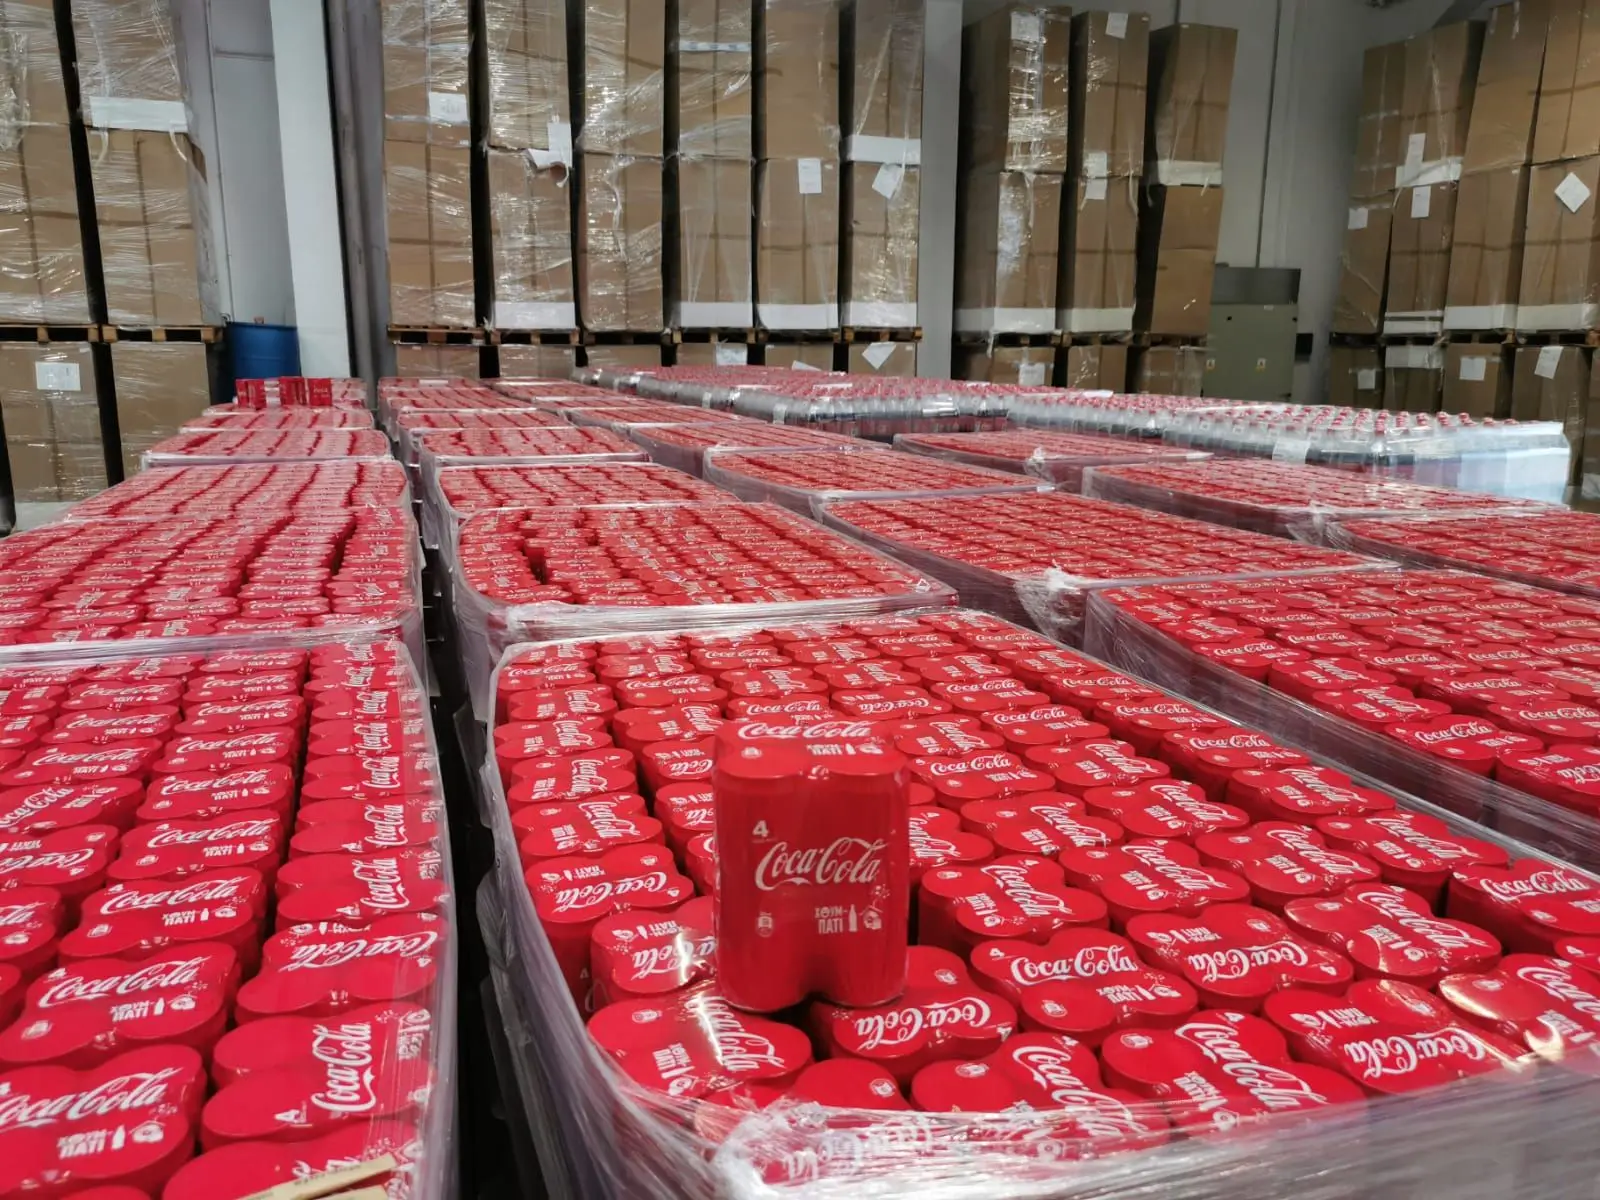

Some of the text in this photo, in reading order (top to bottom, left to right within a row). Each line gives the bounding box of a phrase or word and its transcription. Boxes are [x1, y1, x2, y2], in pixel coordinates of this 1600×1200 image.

[1214, 641, 1276, 656] Coca-Cola
[1288, 632, 1347, 644] Coca-Cola
[705, 649, 770, 658] Coca-Cola
[1374, 654, 1440, 665] Coca-Cola
[203, 674, 291, 688] Coca-Cola
[508, 662, 579, 676] Coca-Cola
[762, 670, 806, 690] Coca-Cola
[1062, 676, 1130, 687] Coca-Cola
[626, 676, 701, 690] Coca-Cola
[946, 679, 1017, 693] Coca-Cola
[1450, 678, 1521, 690] Coca-Cola
[199, 698, 292, 715] Coca-Cola
[354, 690, 389, 714] Coca-Cola
[565, 689, 600, 714] Coca-Cola
[746, 700, 822, 715] Coca-Cola
[859, 698, 930, 714] Coca-Cola
[993, 705, 1068, 724] Coca-Cola
[1116, 703, 1191, 715] Coca-Cola
[1520, 706, 1598, 720] Coca-Cola
[67, 713, 169, 729] Coca-Cola
[681, 706, 723, 731] Coca-Cola
[737, 720, 877, 740] Coca-Cola
[176, 732, 282, 753] Coca-Cola
[353, 722, 392, 750] Coca-Cola
[552, 720, 593, 747] Coca-Cola
[930, 721, 991, 752] Coca-Cola
[1189, 734, 1271, 749] Coca-Cola
[1414, 721, 1493, 744] Coca-Cola
[32, 747, 151, 766] Coca-Cola
[930, 752, 1013, 775] Coca-Cola
[1085, 743, 1160, 775] Coca-Cola
[161, 769, 272, 795] Coca-Cola
[361, 755, 400, 789] Coca-Cola
[571, 759, 608, 794] Coca-Cola
[1279, 768, 1368, 803] Coca-Cola
[1150, 784, 1241, 822] Coca-Cola
[147, 818, 280, 848] Coca-Cola
[364, 804, 409, 846] Coca-Cola
[578, 801, 640, 838] Coca-Cola
[752, 820, 769, 837] 4
[1030, 805, 1111, 848] Coca-Cola
[1366, 818, 1483, 859] Coca-Cola
[755, 836, 888, 891] Coca-Cola
[1266, 829, 1377, 876] Coca-Cola
[1121, 845, 1232, 890] Coca-Cola
[100, 876, 251, 916] Coca-Cola
[352, 857, 410, 909] Coca-Cola
[552, 872, 667, 913] Coca-Cola
[980, 865, 1076, 916] Coca-Cola
[1479, 869, 1590, 902] Coca-Cola
[1357, 891, 1490, 949] Coca-Cola
[278, 931, 438, 973] Coca-Cola
[1010, 945, 1138, 985] Coca-Cola
[1188, 940, 1308, 983] Coca-Cola
[38, 955, 212, 1008] Coca-Cola
[855, 996, 991, 1051] Coca-Cola
[1175, 1022, 1328, 1108] Coca-Cola
[1344, 1026, 1486, 1078] Coca-Cola
[310, 1022, 376, 1113] Coca-Cola
